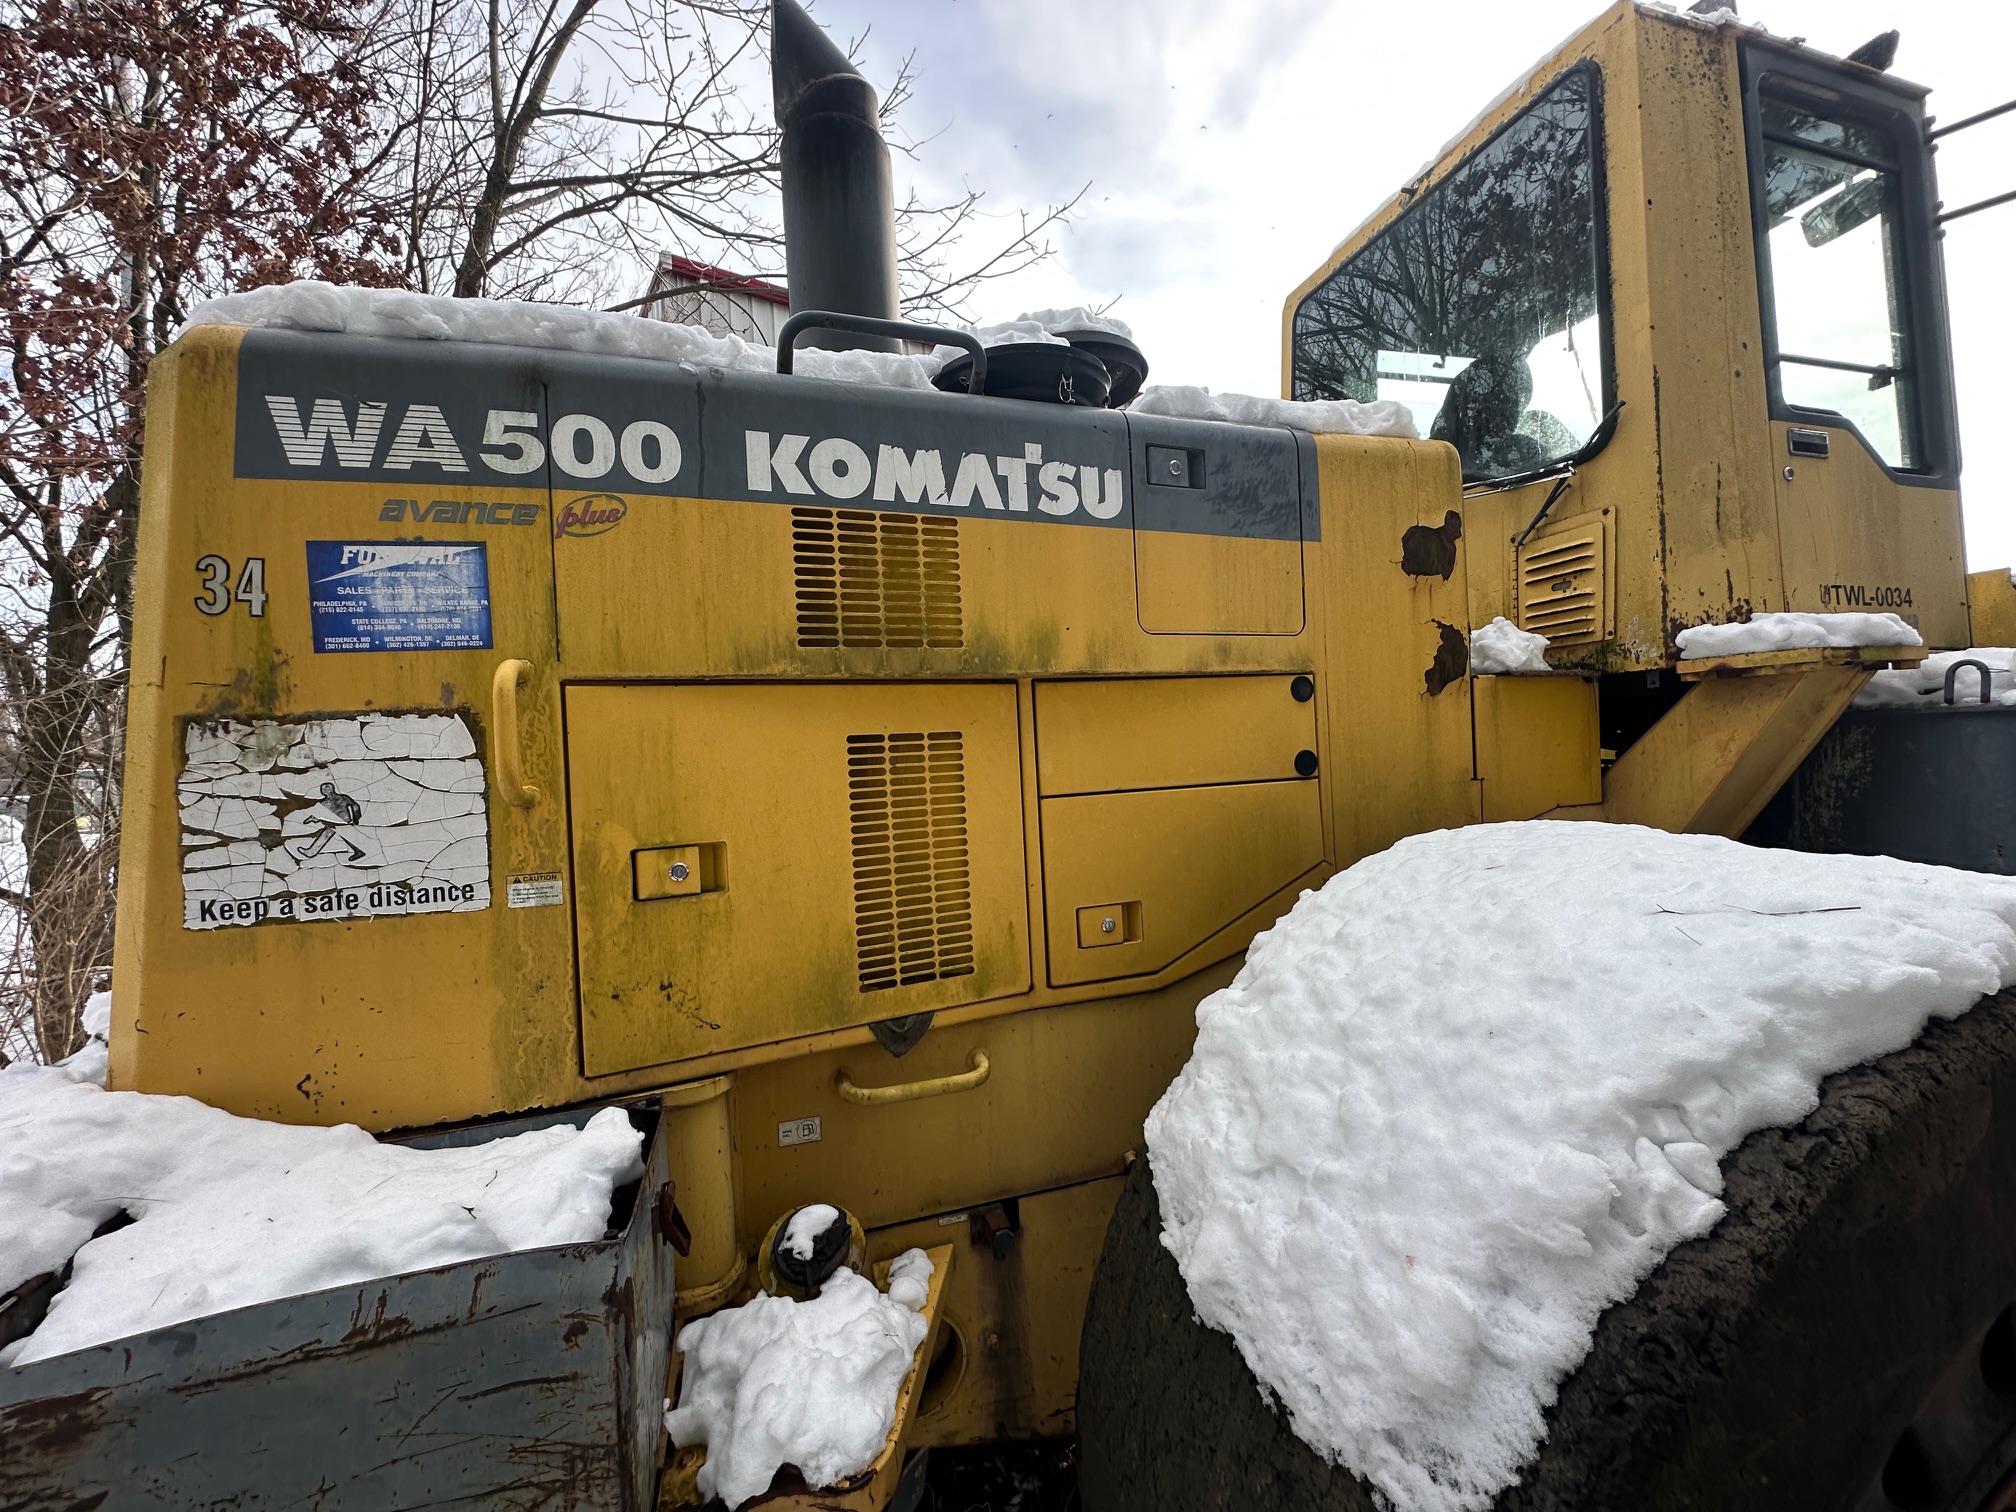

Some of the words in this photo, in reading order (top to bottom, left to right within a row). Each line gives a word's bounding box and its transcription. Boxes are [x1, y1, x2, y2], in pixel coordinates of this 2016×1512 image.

[745, 430, 1123, 519] KOMATSU
[379, 498, 540, 526] avance
[555, 500, 622, 539] plus
[194, 554, 269, 617] 34
[337, 586, 372, 595] SALES
[424, 585, 469, 595] SERVICE
[362, 570, 405, 578] MACHINERY
[1819, 583, 1913, 608] UTWL-0034
[522, 874, 557, 882] CAUTION
[200, 898, 268, 923] Keep
[279, 897, 294, 915] a
[304, 889, 359, 913] safe
[369, 883, 475, 908] distance
